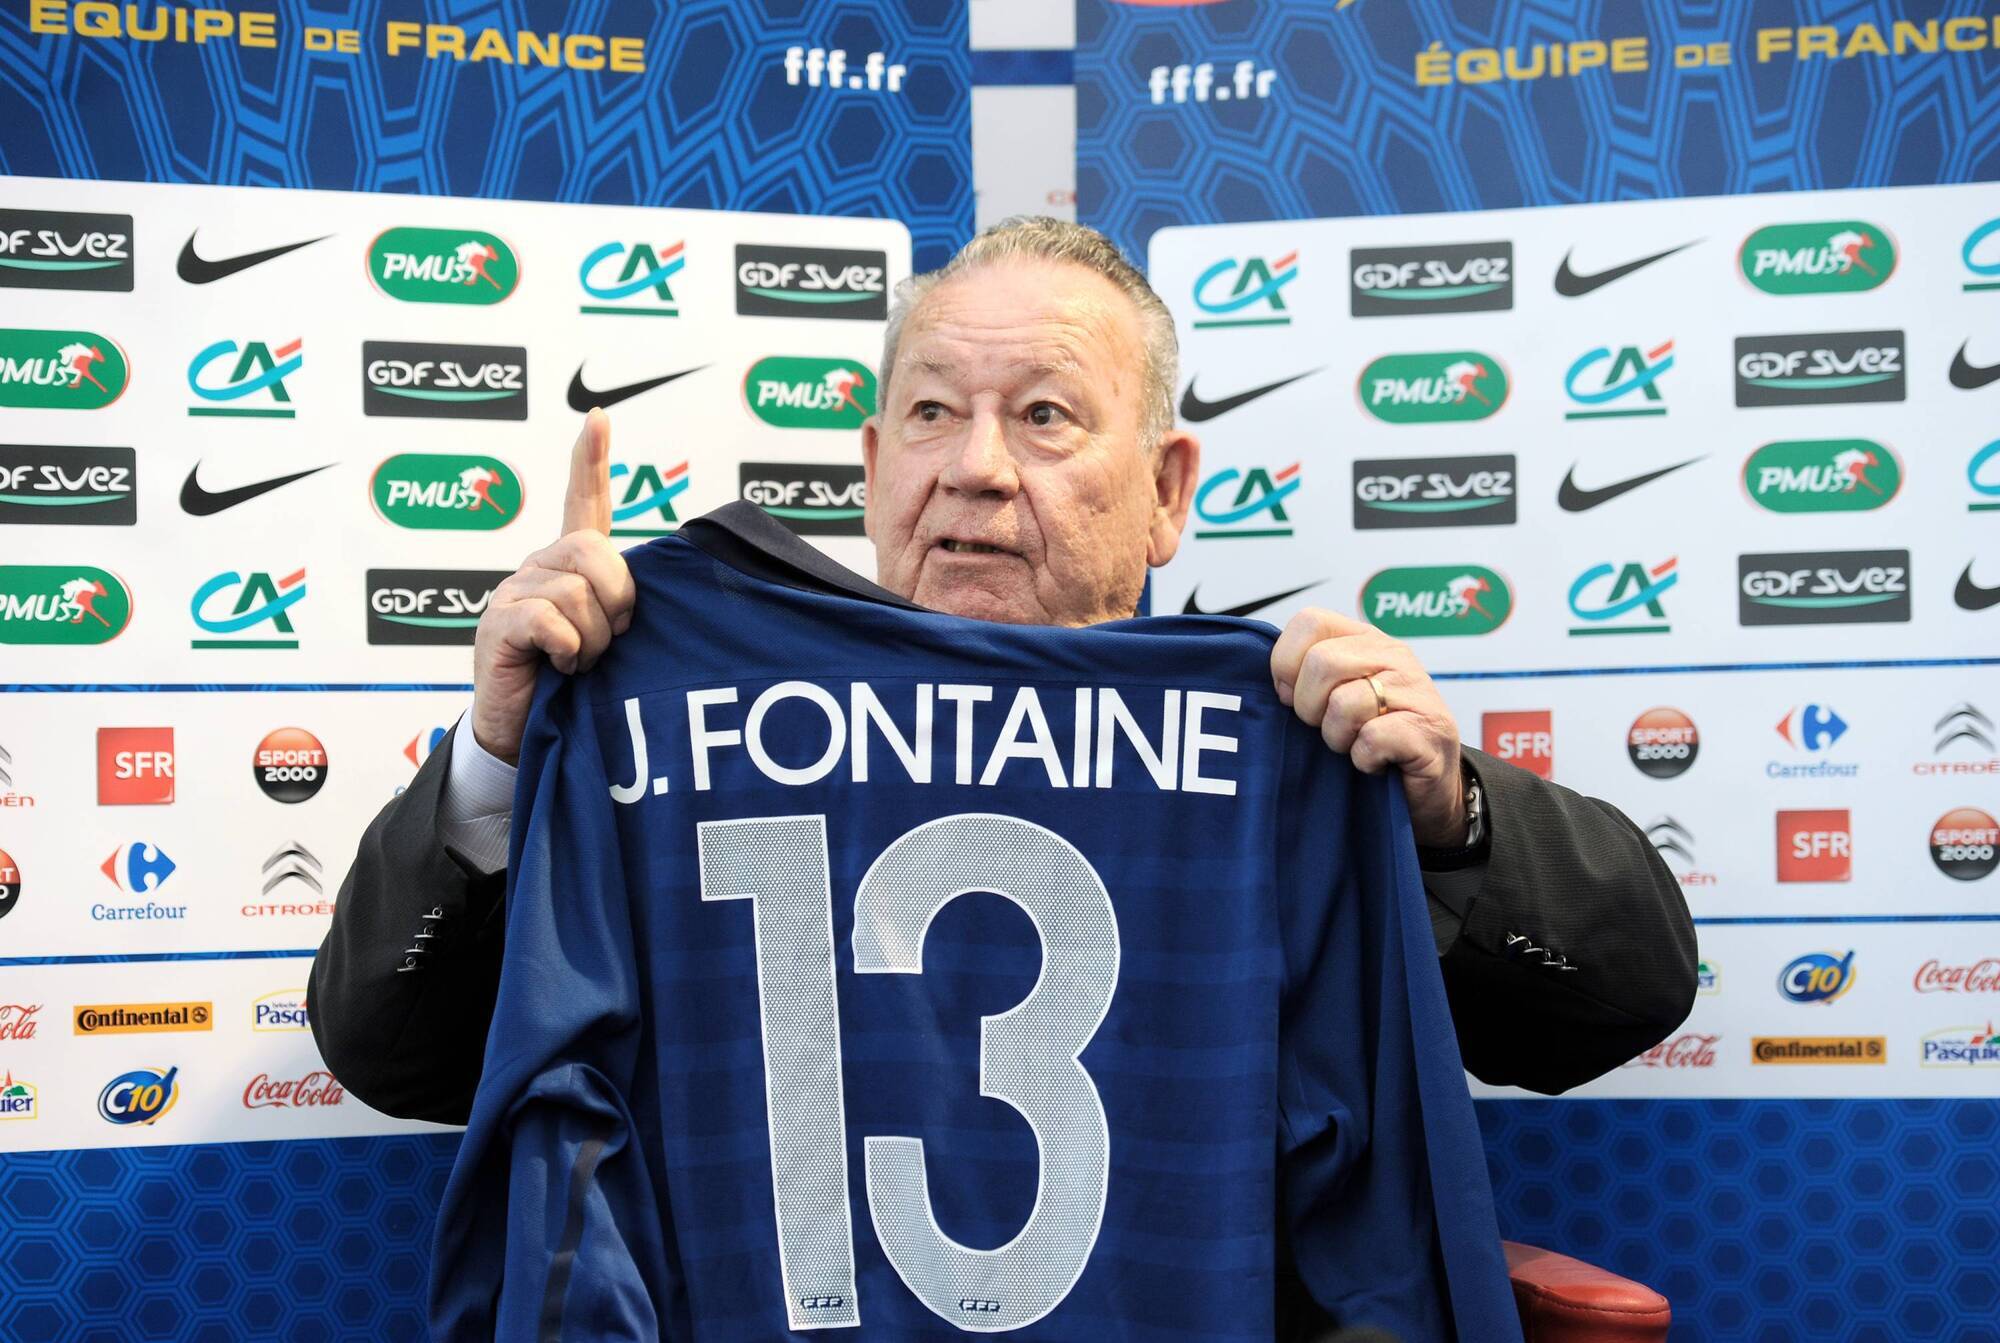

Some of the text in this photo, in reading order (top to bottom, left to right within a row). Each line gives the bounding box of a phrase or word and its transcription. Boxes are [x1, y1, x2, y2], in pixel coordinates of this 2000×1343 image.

[304, 27, 360, 54] DE
[386, 22, 646, 73] FRANCE
[1415, 17, 2000, 86] ÉQUIPE DE FRANC
[785, 46, 905, 92] fff.fr
[1149, 60, 1276, 104] fff.fr
[382, 251, 457, 284] PMU
[738, 261, 800, 288] GDF
[1354, 262, 1419, 290] GDF
[1753, 247, 1827, 277] PMU
[367, 359, 437, 388] GDF
[1738, 350, 1807, 379] GDF
[757, 380, 823, 409] PMU
[1372, 377, 1443, 406] PMU
[386, 480, 460, 509] PMU
[743, 480, 802, 505] GDF
[1356, 475, 1422, 502] GDF
[1758, 466, 1832, 496] PMU
[1742, 571, 1811, 597] GDF
[371, 588, 438, 614] GDF
[1375, 591, 1446, 619] PMU
[609, 681, 1241, 804] J. FONTAINE
[1497, 732, 1551, 759] SFR
[1632, 727, 1694, 744] SPORT
[114, 751, 174, 780] SFR
[259, 749, 322, 766] SPORT
[1637, 745, 1690, 760] 2000
[264, 766, 317, 782] 2000
[1767, 761, 1859, 778] Carrefour
[1793, 831, 1850, 858] SFR
[1933, 828, 1998, 846] SPORT
[1940, 845, 1993, 861] 2000
[91, 902, 187, 921] Carrefour
[1790, 962, 1843, 994] C10
[77, 1006, 189, 1031] Continental
[1755, 1041, 1862, 1060] Continental
[697, 813, 1121, 1333] 13
[103, 1083, 162, 1114] C10
[243, 1071, 344, 1109] Coca-Cola
